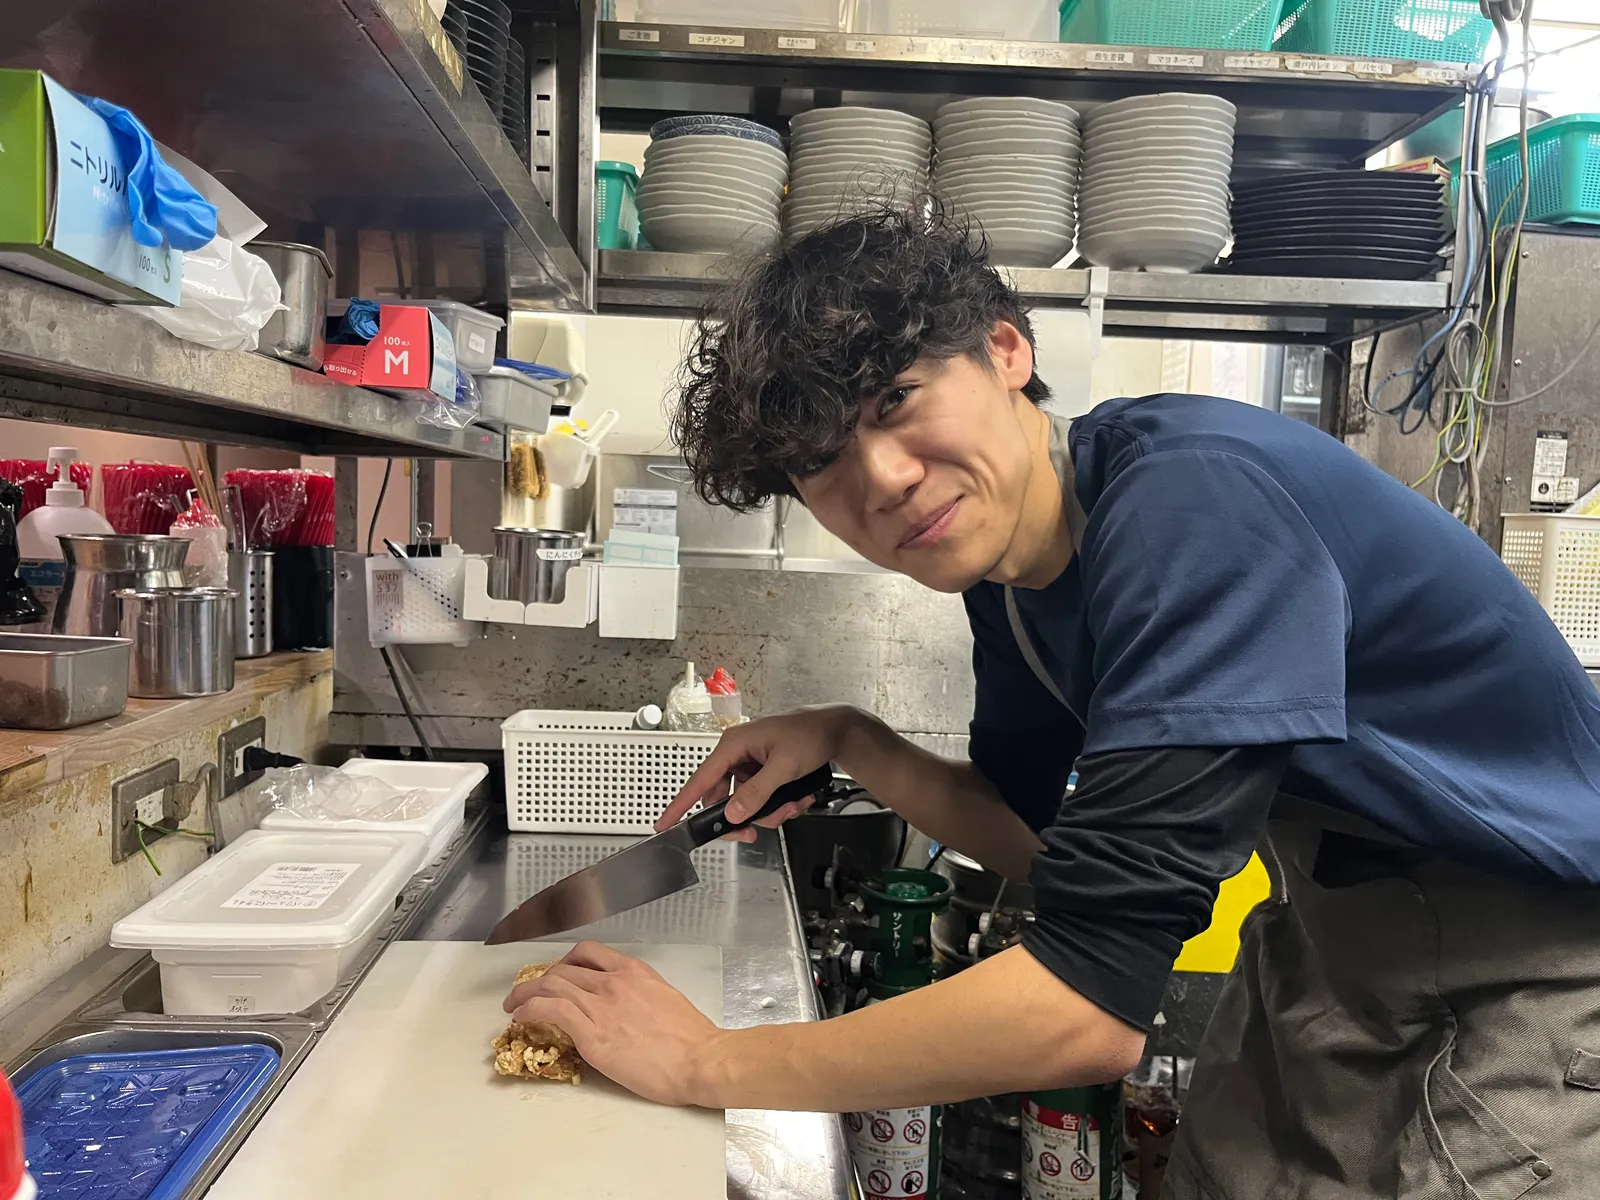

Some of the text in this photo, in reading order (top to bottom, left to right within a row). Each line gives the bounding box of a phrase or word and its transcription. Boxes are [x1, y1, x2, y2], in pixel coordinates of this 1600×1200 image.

[697, 35, 736, 45] コチジャン
[1156, 55, 1195, 65] マヨネーズ
[70, 140, 127, 197] ニトリル
[163, 252, 171, 283] S
[384, 349, 409, 375] M
[375, 571, 399, 582] with
